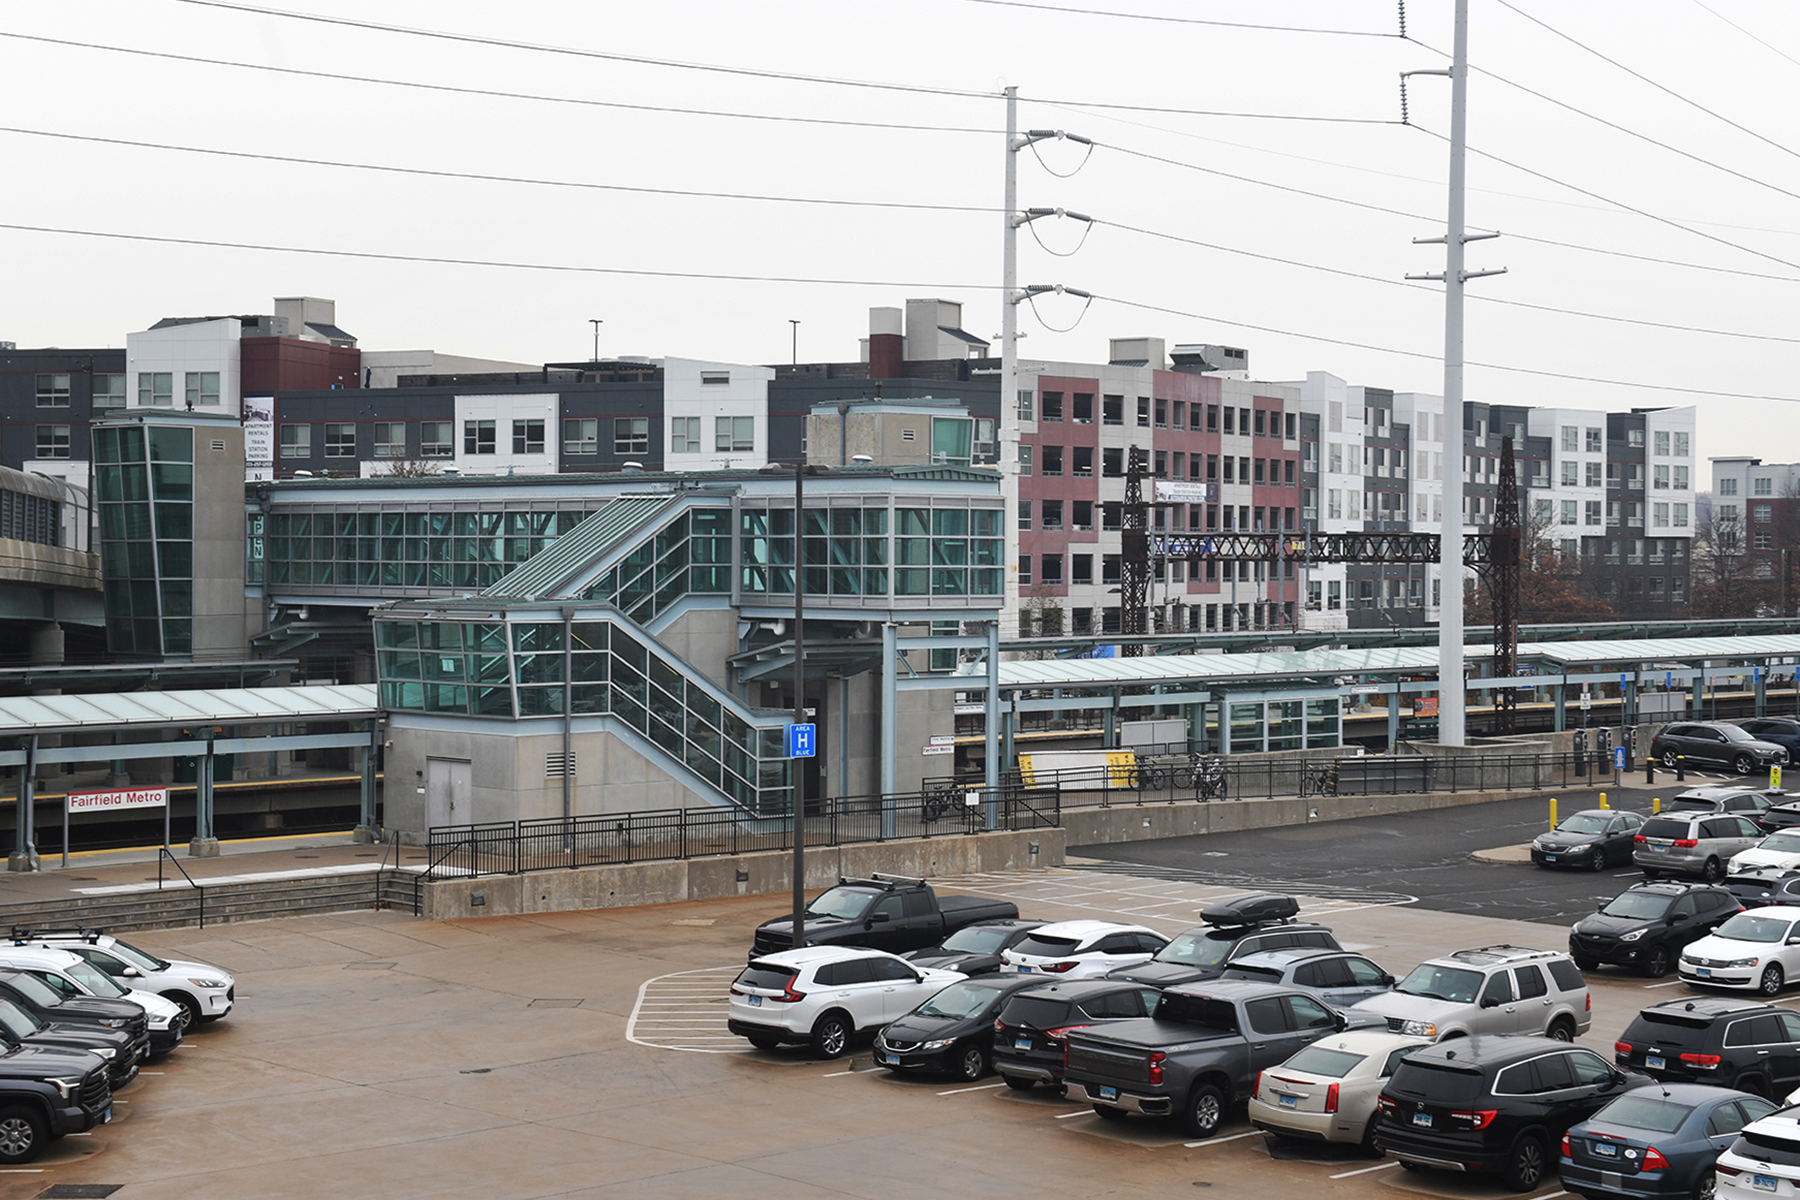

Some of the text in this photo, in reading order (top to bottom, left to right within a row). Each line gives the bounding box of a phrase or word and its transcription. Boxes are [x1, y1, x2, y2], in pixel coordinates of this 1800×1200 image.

[798, 733, 808, 748] H
[71, 792, 162, 807] Fairfield Metro
